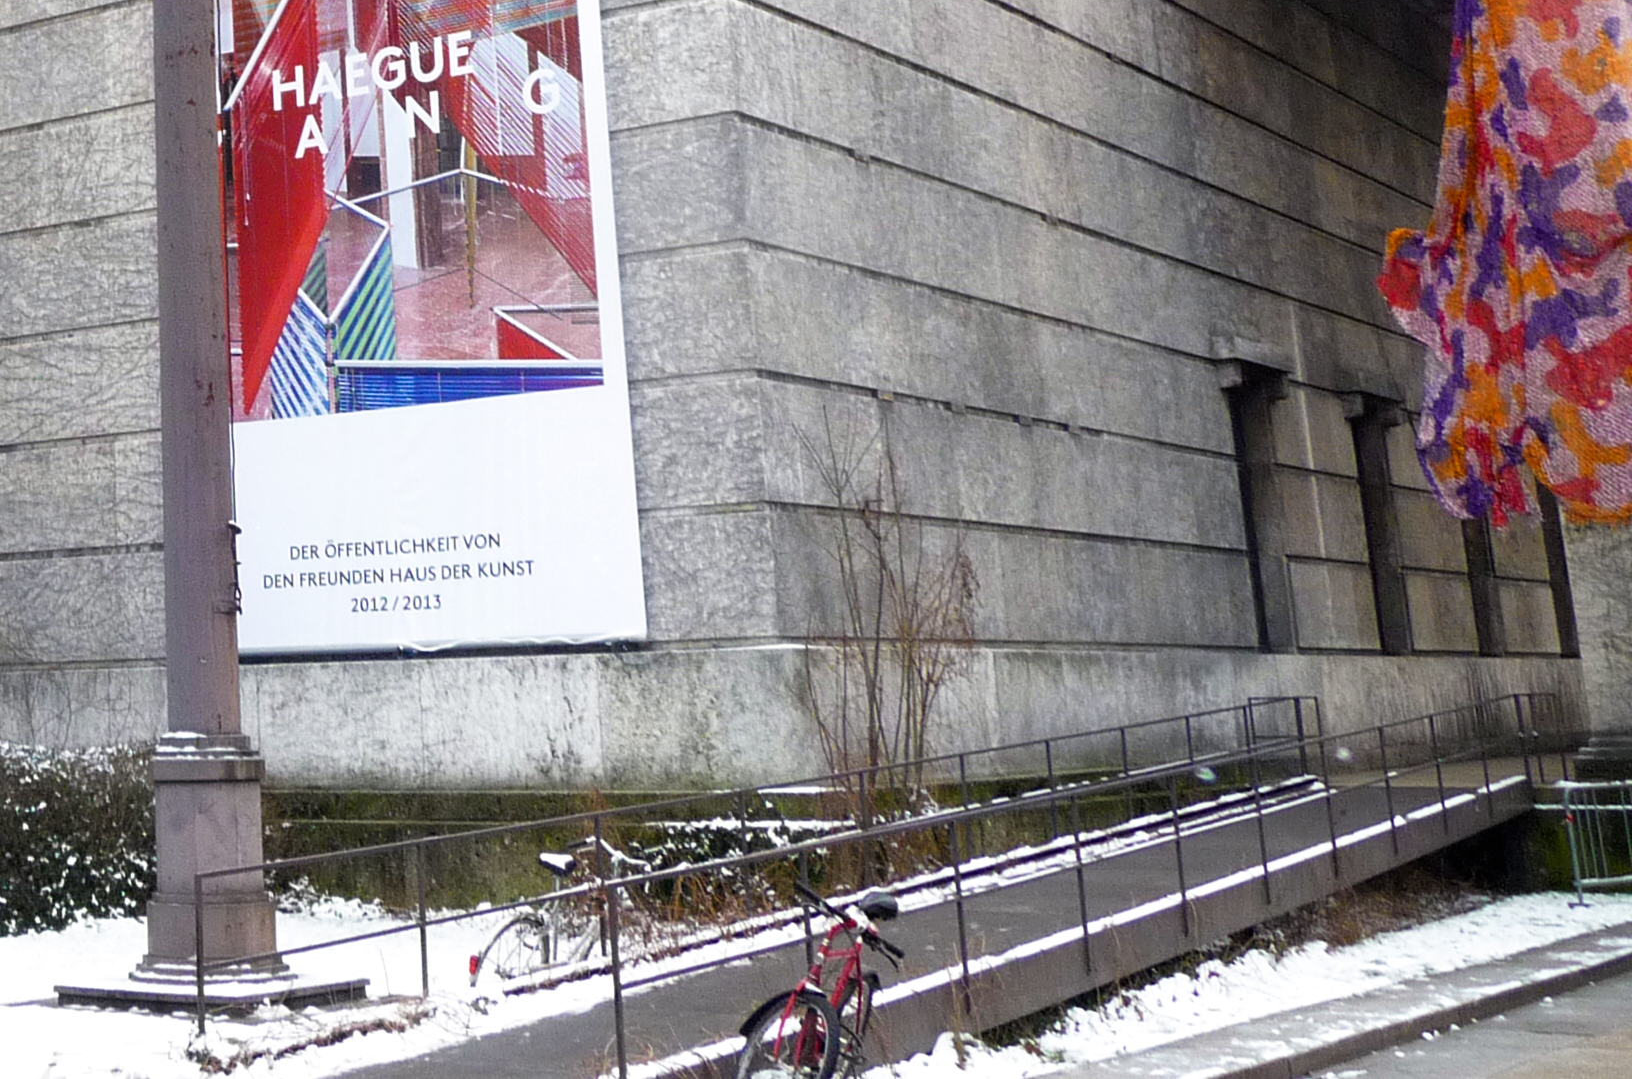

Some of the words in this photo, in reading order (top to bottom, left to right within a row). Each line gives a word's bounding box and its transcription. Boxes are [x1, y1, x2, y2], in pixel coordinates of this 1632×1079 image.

[271, 30, 474, 111] HAEGUE
[216, 68, 561, 160] ANG
[263, 573, 295, 590] DEN
[299, 568, 385, 588] FREUNDEN
[389, 565, 437, 583] HAUS
[441, 563, 473, 581] DER
[477, 559, 535, 578] KUNST
[289, 544, 320, 561] DER
[324, 535, 460, 559] ÖFFENTLICHKEIT
[464, 533, 501, 550] VON
